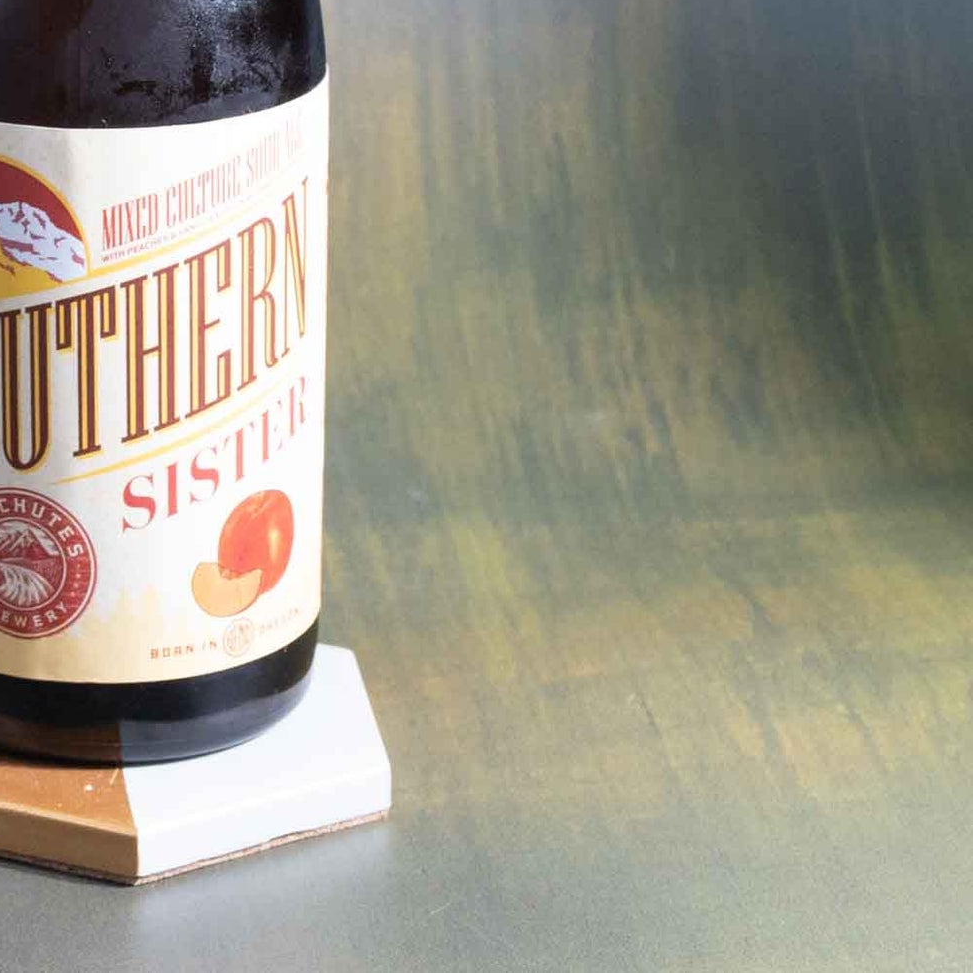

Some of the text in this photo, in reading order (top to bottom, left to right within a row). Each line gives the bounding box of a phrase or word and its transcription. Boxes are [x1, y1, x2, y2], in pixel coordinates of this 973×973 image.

[101, 192, 159, 251] MIXED
[165, 155, 241, 228] CULTURE
[120, 376, 310, 536] SISTER
[150, 643, 195, 659] BORN
